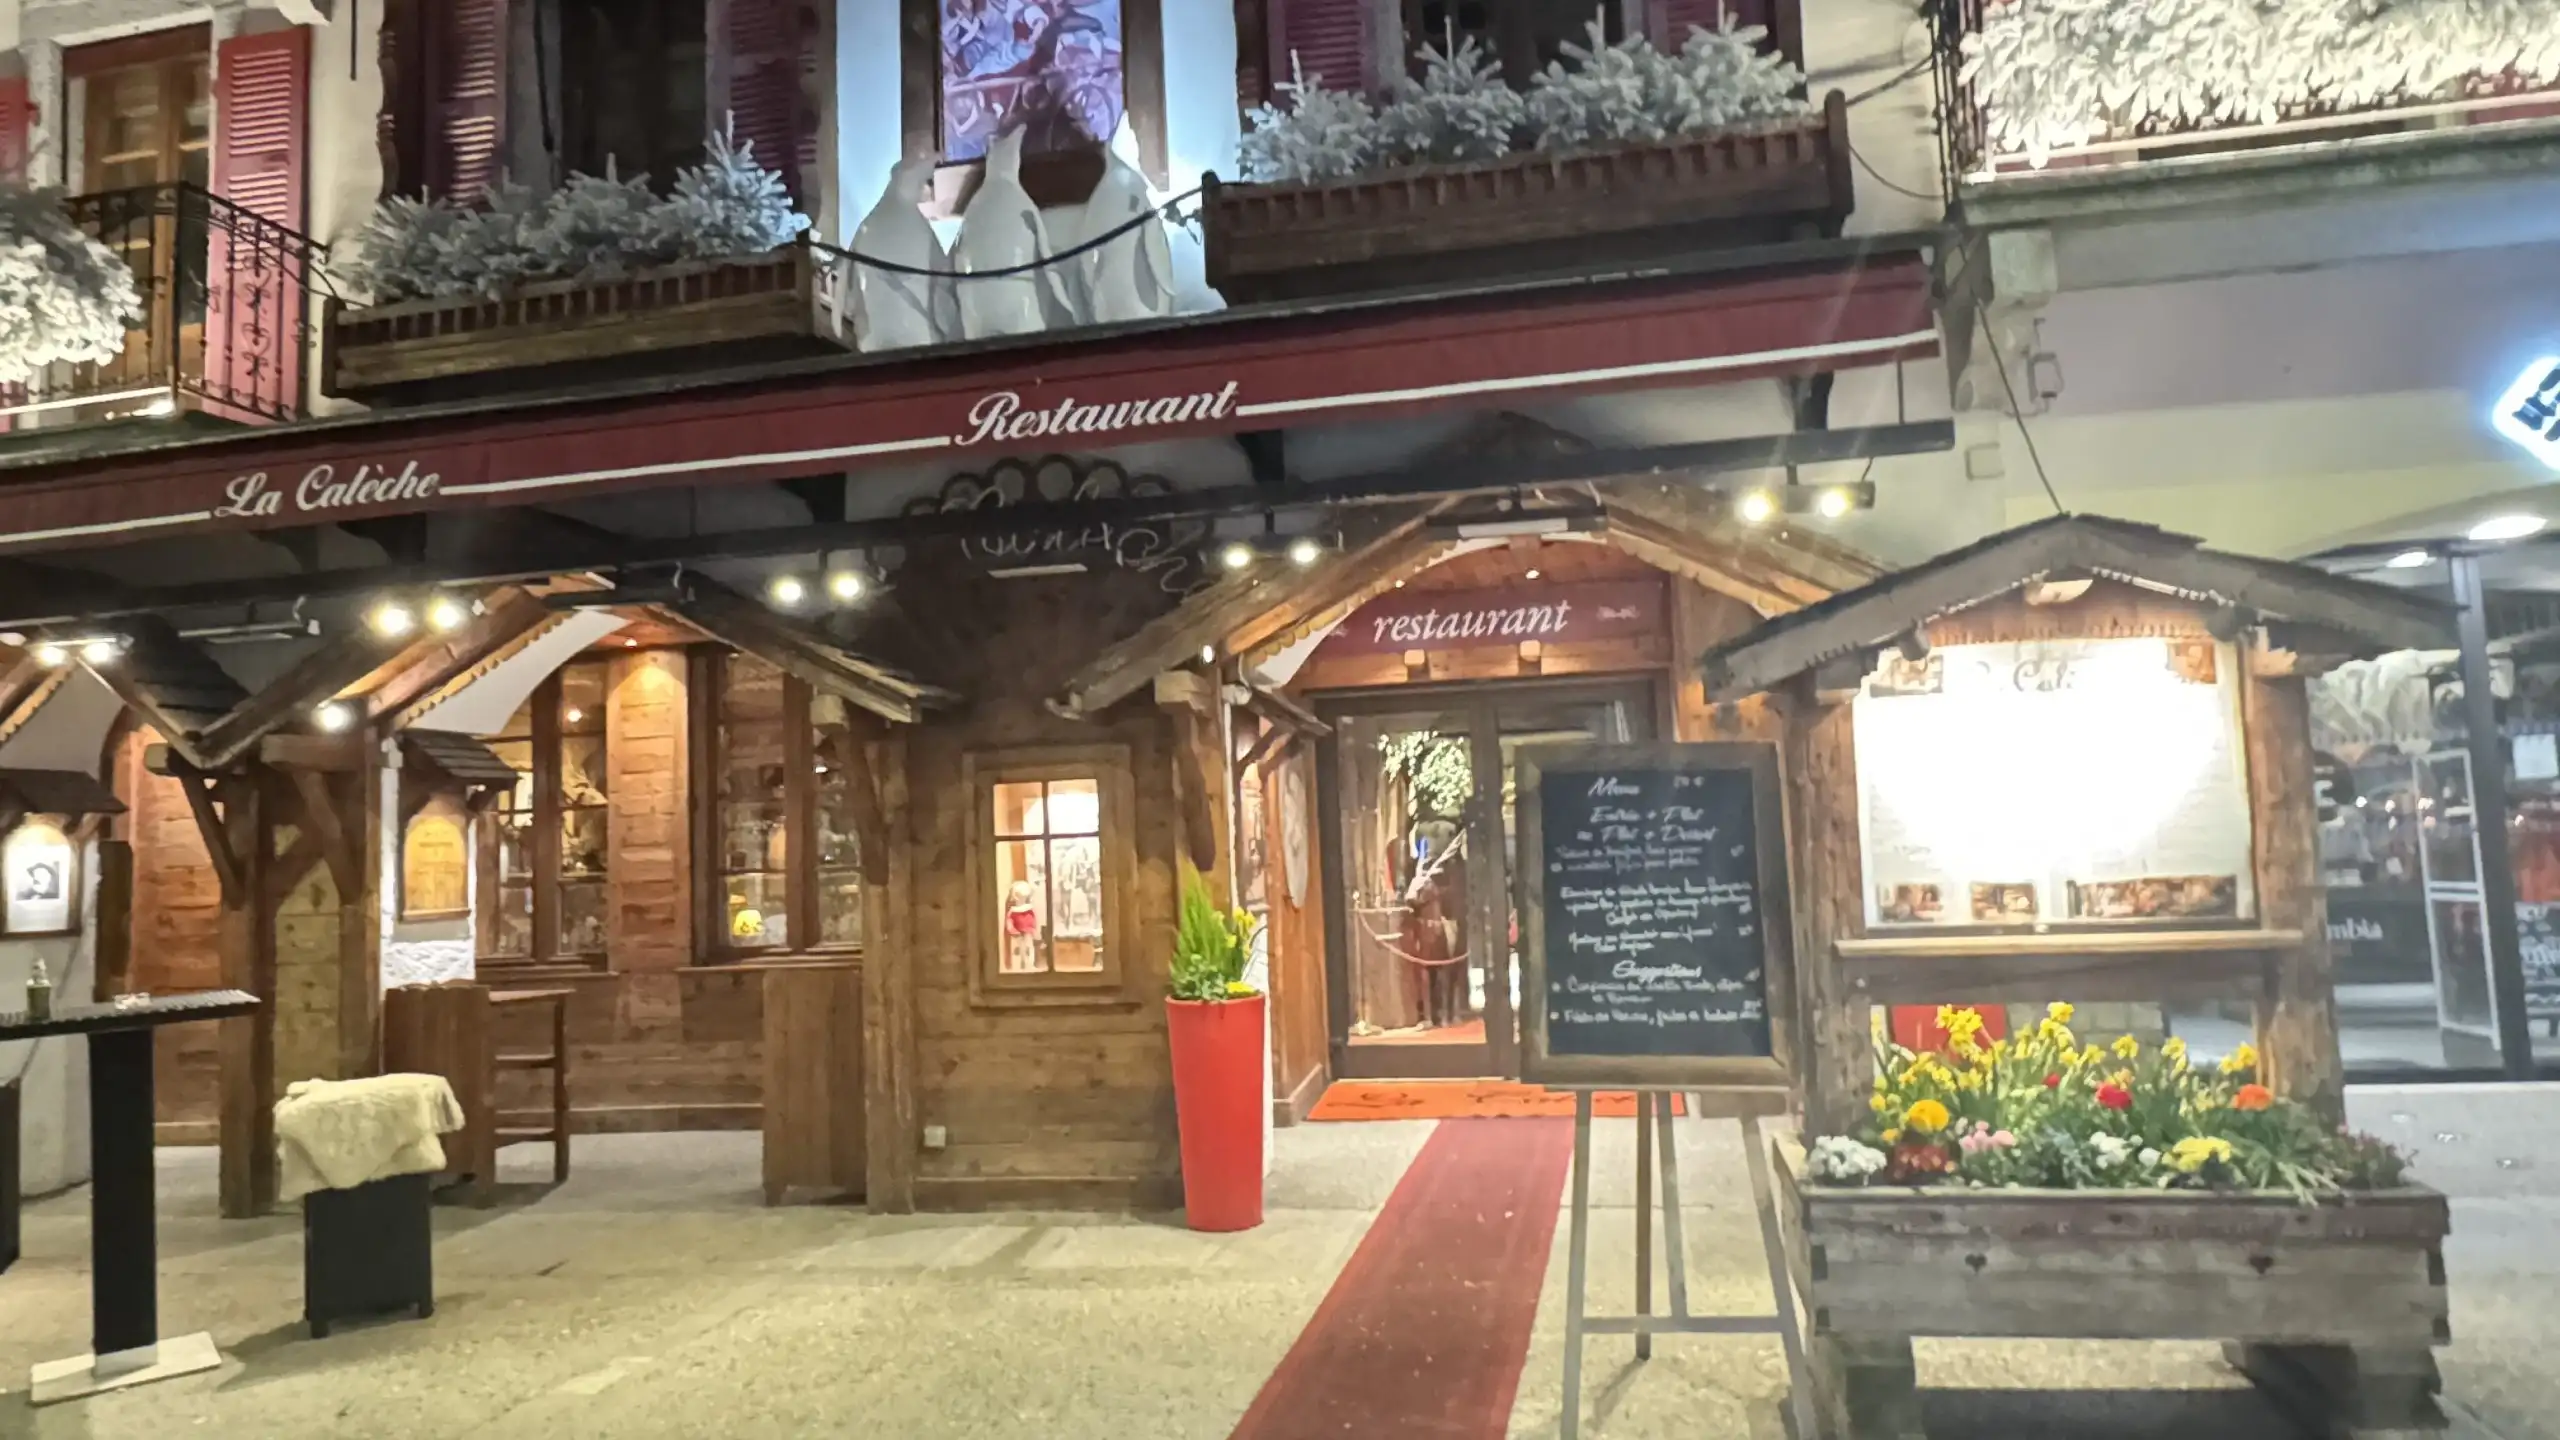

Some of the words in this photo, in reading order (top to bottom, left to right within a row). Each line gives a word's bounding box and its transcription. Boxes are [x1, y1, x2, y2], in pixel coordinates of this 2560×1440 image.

[954, 380, 1239, 446] Restaurant
[214, 471, 283, 518] La
[295, 460, 441, 512] Calèche
[1373, 600, 1572, 643] restaurant
[1587, 776, 1640, 796] Menu
